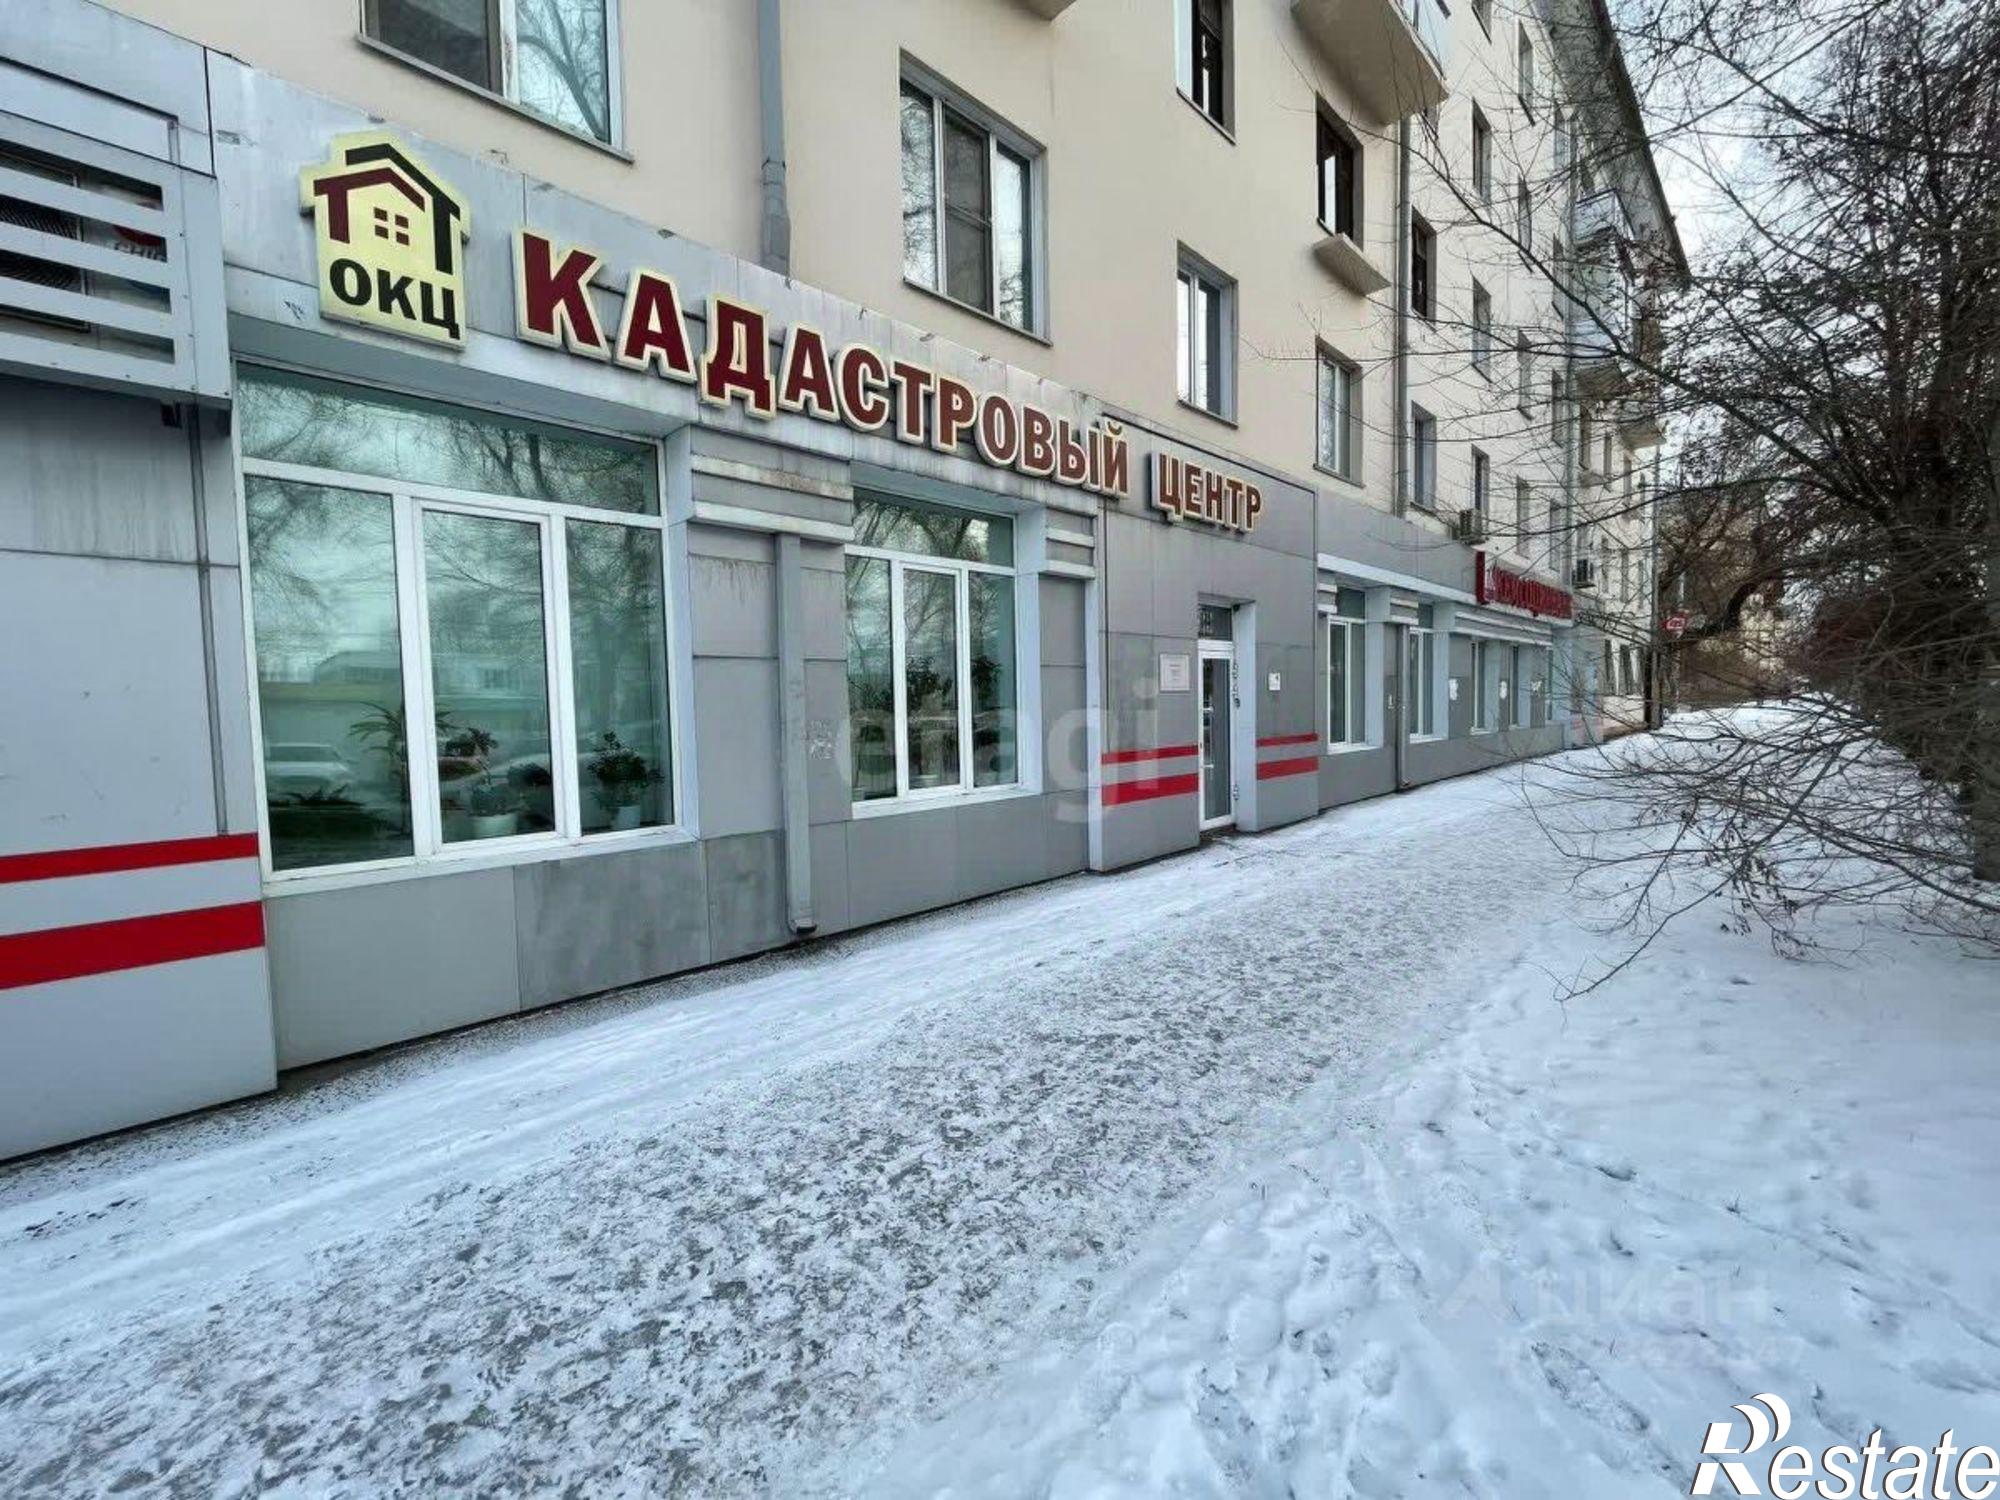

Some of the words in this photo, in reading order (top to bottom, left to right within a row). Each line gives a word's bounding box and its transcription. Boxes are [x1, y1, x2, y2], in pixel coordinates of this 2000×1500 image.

[329, 258, 460, 341] ОКЦ
[517, 230, 1130, 497] КАДАСТРОВЫЙ
[1153, 451, 1262, 531] ЦЕНТР
